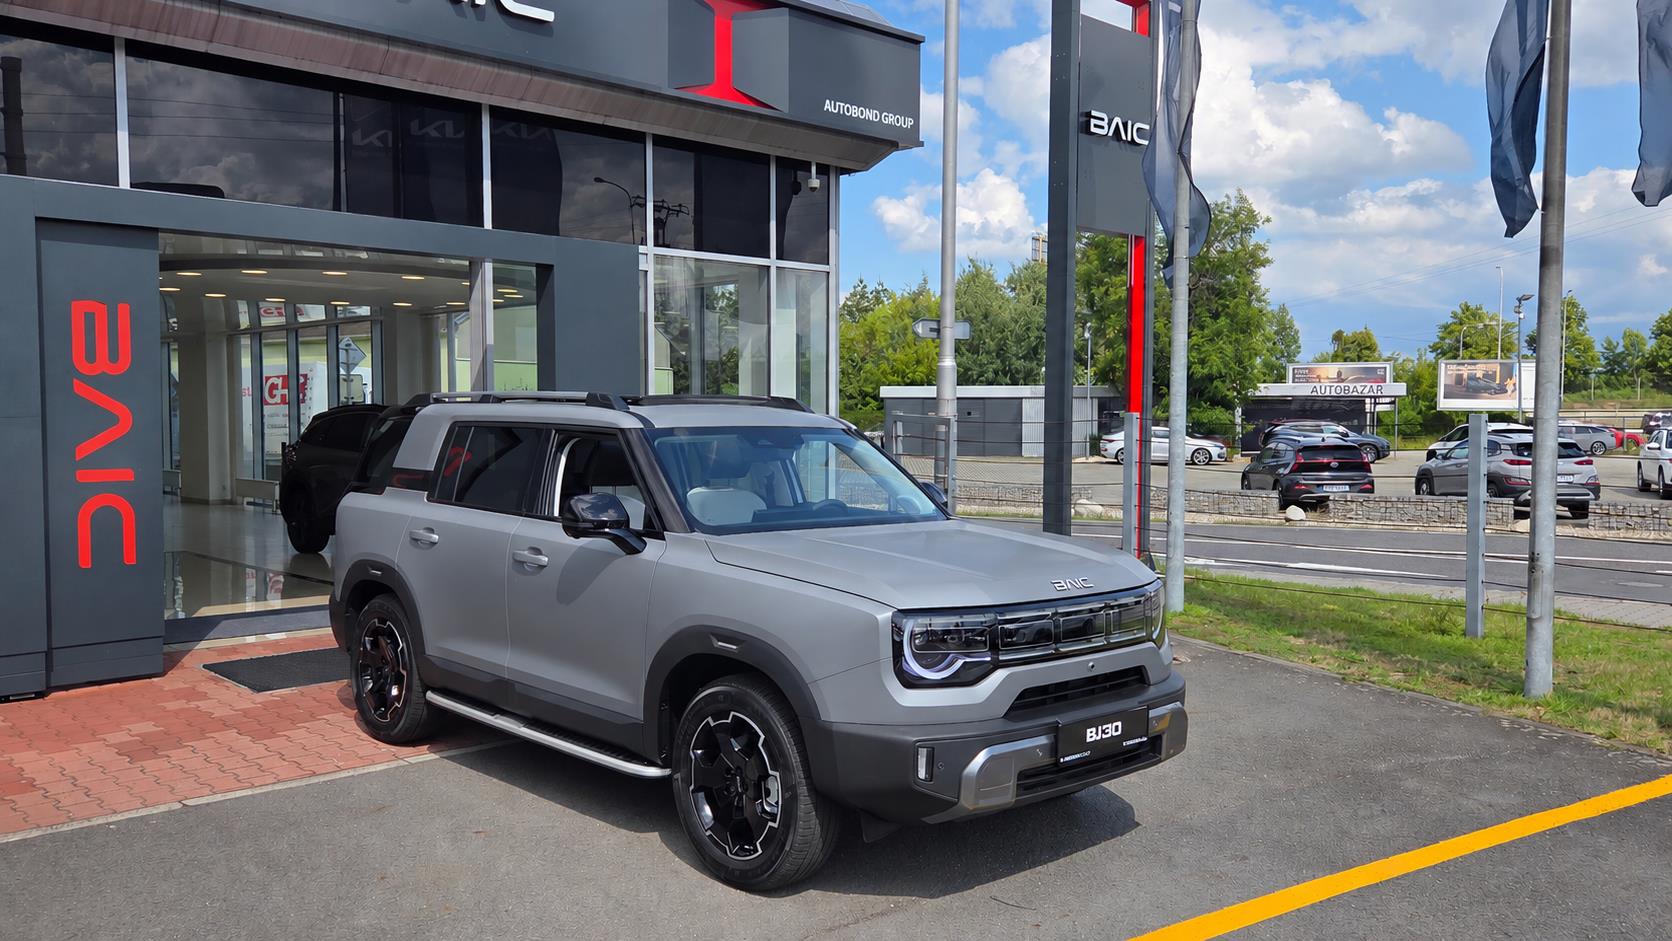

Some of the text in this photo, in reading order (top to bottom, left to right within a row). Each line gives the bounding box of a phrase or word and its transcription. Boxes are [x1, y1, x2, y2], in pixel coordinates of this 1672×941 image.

[823, 99, 914, 129] AUTOBOND GROUP
[1090, 109, 1150, 146] BAIC
[1310, 384, 1384, 395] AUTOBAZAR
[71, 300, 137, 568] BAIC
[1051, 577, 1095, 591] BAIC
[1085, 720, 1122, 743] BJ30
